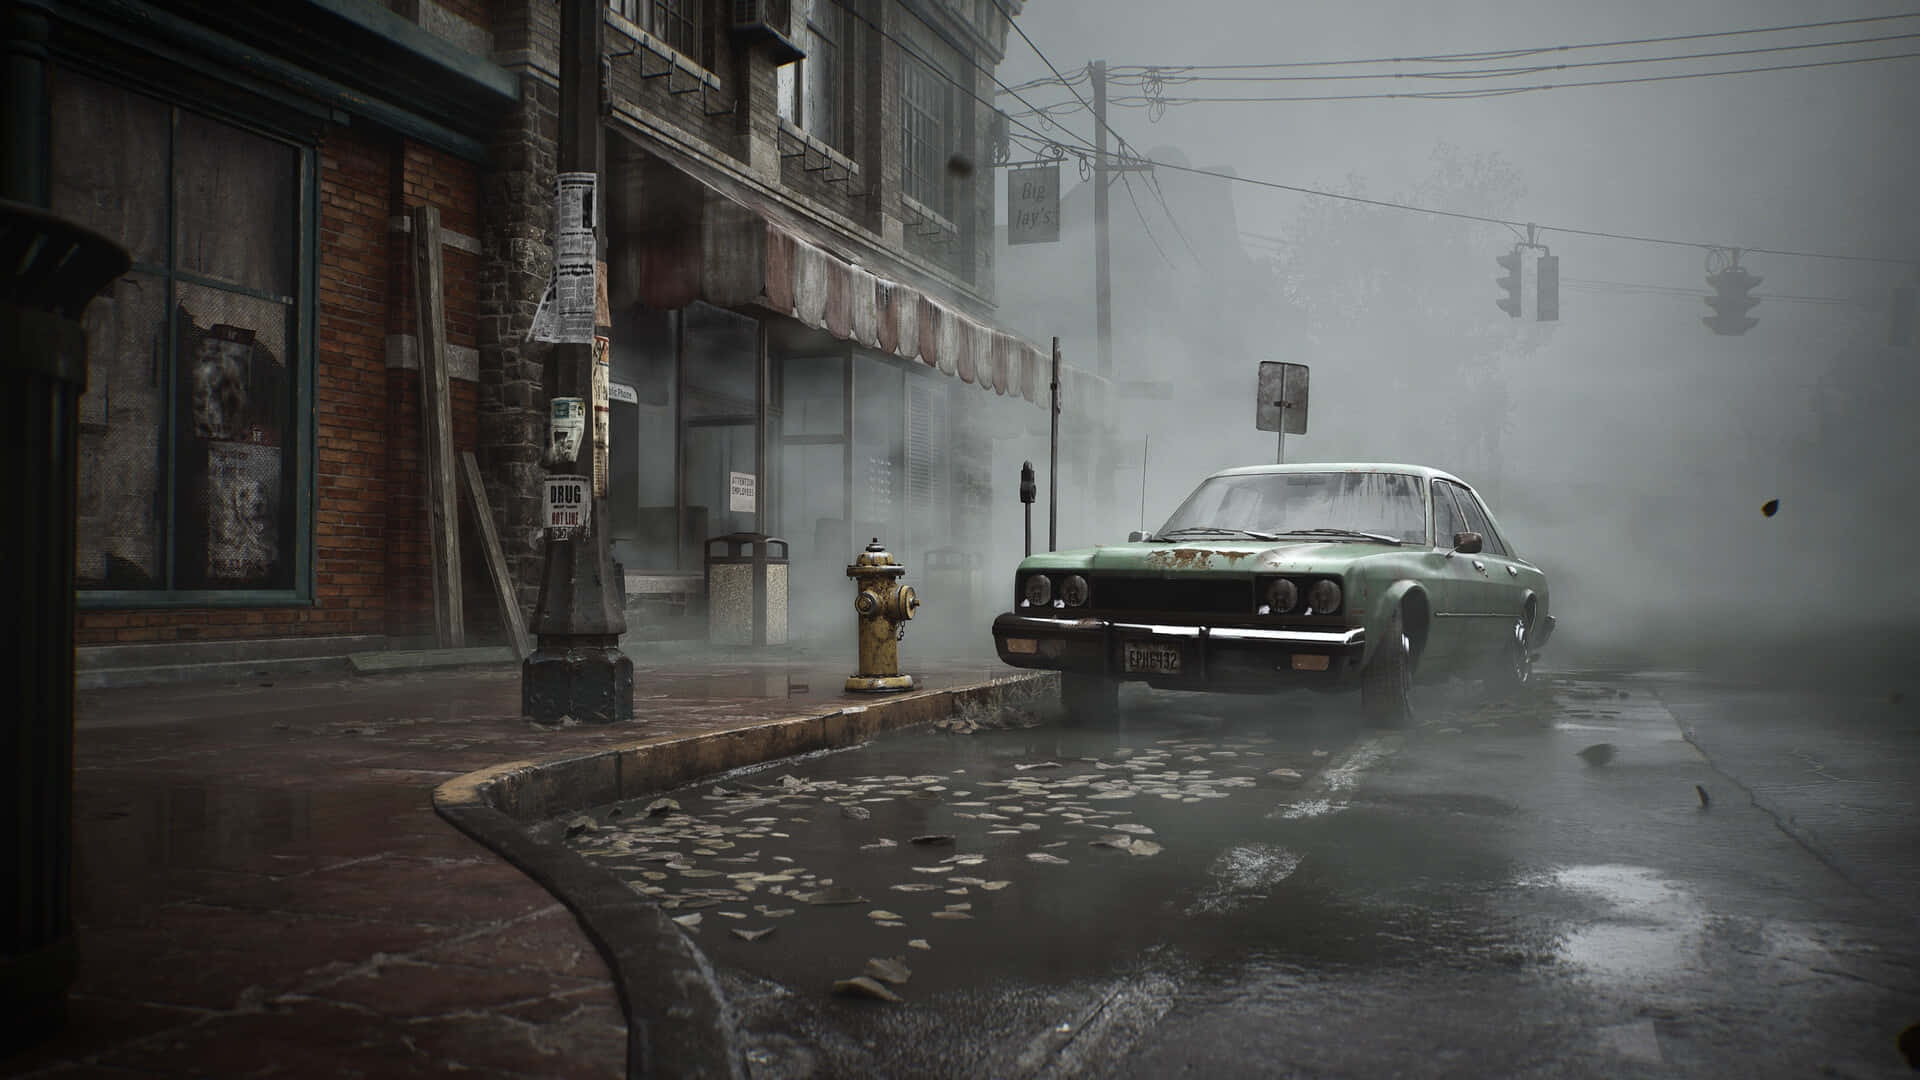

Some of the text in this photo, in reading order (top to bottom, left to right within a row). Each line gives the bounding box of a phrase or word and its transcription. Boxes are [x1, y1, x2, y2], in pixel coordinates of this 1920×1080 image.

[1022, 182, 1046, 202] Big
[617, 388, 632, 400] Phone
[550, 485, 581, 504] DRUG
[731, 487, 754, 496] EMPLOYEES
[551, 512, 579, 525] HOT LINE
